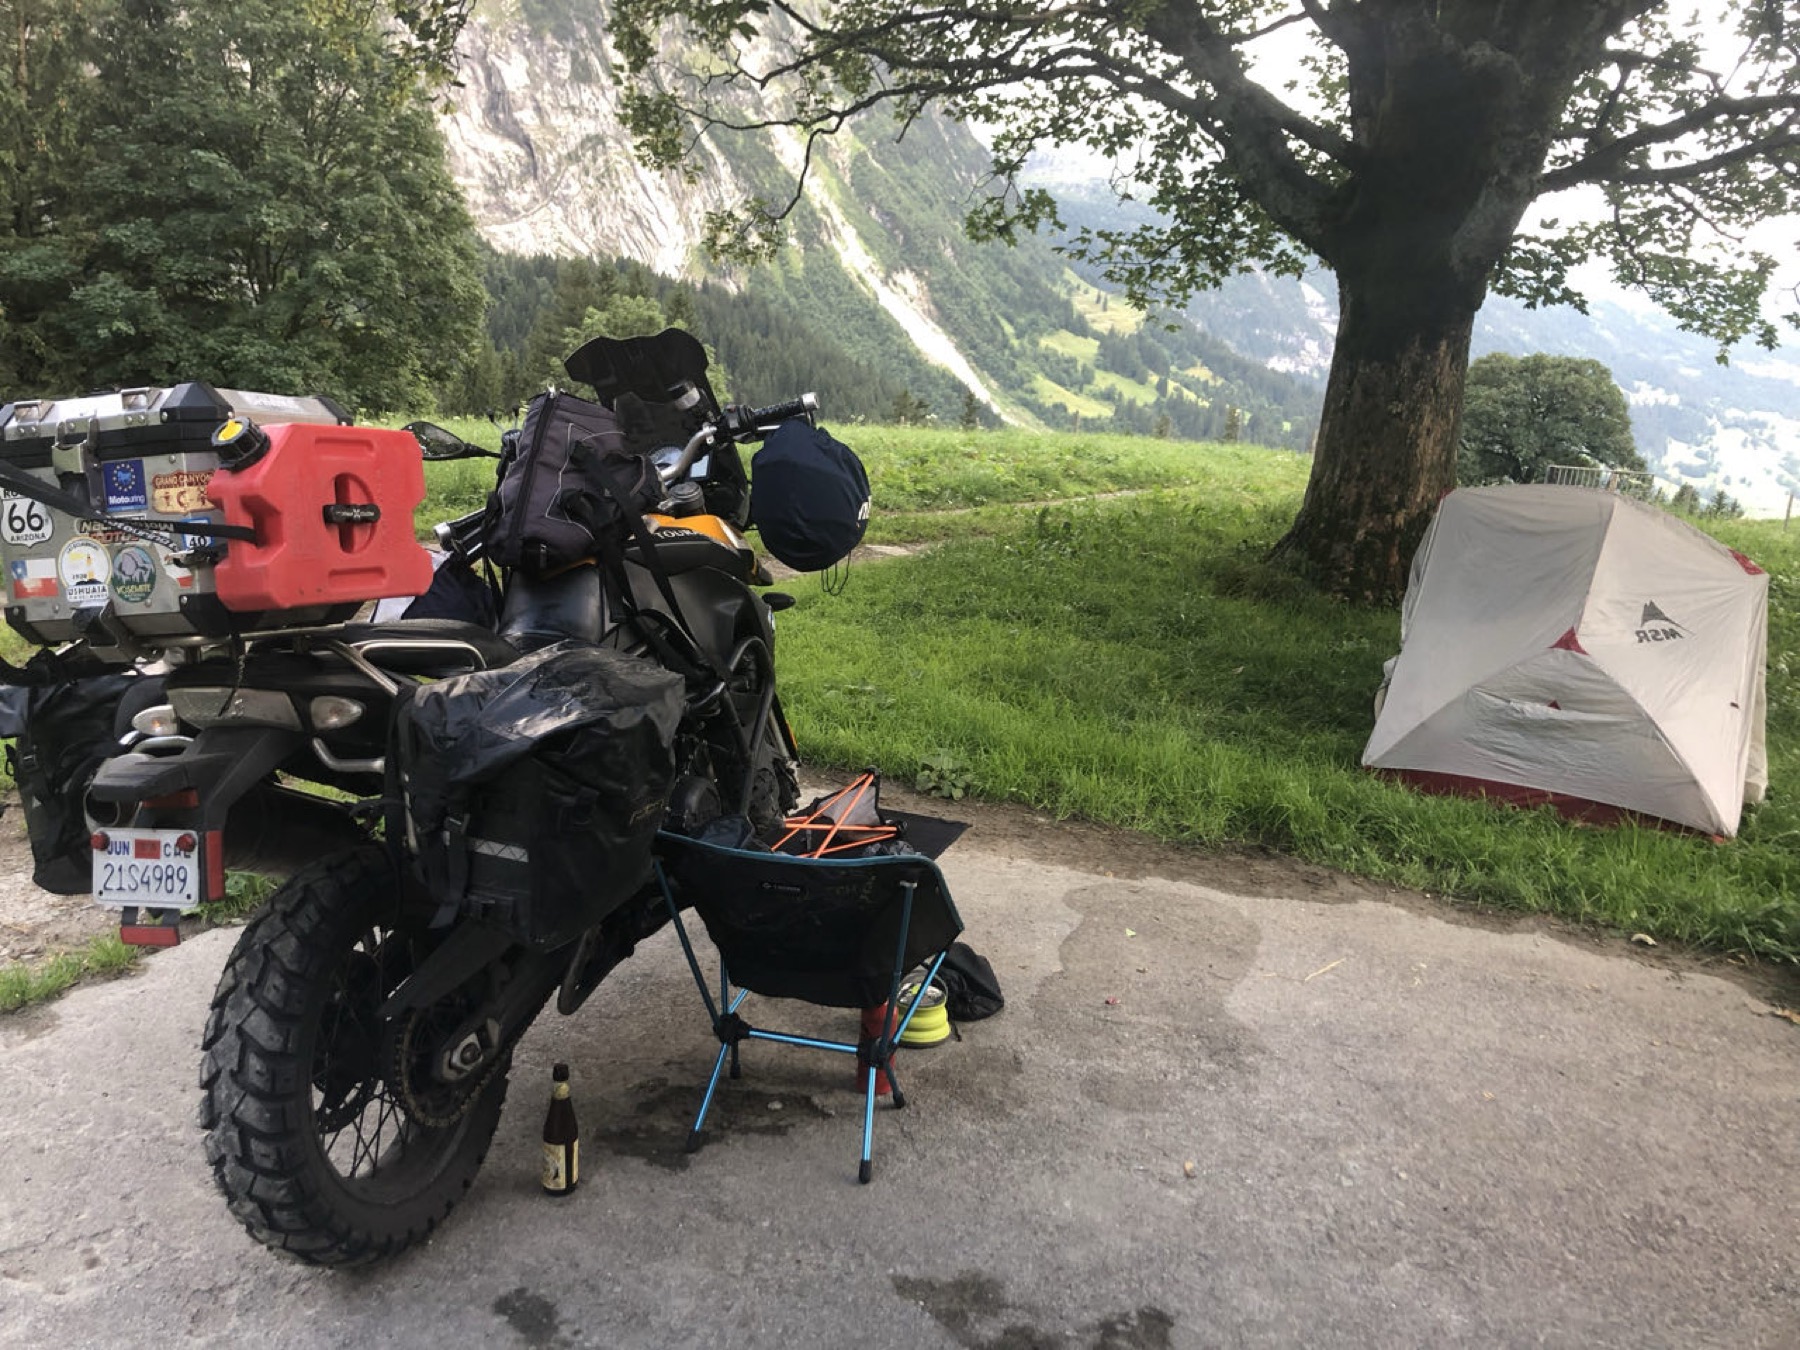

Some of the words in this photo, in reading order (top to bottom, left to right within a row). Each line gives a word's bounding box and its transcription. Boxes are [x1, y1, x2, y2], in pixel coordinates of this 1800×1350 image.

[155, 475, 178, 486] GRAND
[9, 501, 43, 533] 66
[11, 532, 46, 541] ARIZONA
[189, 535, 208, 547] 40
[68, 585, 107, 596] USHUAIA
[116, 584, 151, 594] YOSEMITE
[107, 840, 130, 856] JUN
[103, 863, 188, 894] 21S4989
